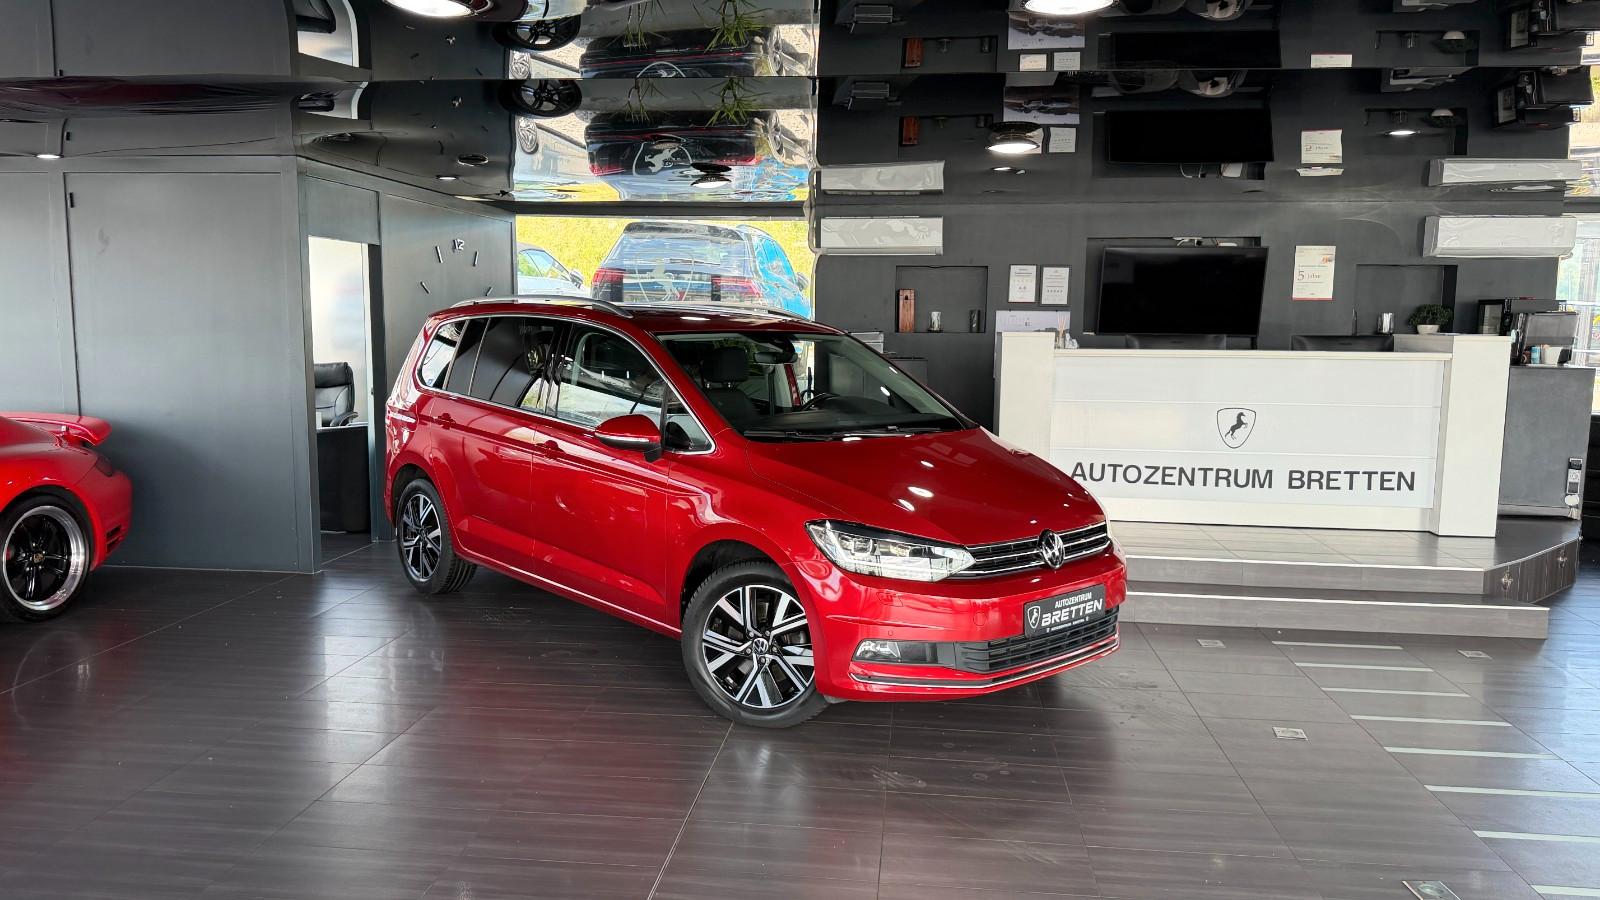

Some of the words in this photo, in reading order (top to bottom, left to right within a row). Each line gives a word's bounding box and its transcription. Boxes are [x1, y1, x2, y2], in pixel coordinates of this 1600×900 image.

[1070, 462, 1273, 489] AUTOZENTRUM
[1288, 469, 1415, 492] BRETTEN
[1041, 598, 1103, 627] BRETTEN
[1054, 592, 1092, 609] AUTOZENTRUM
